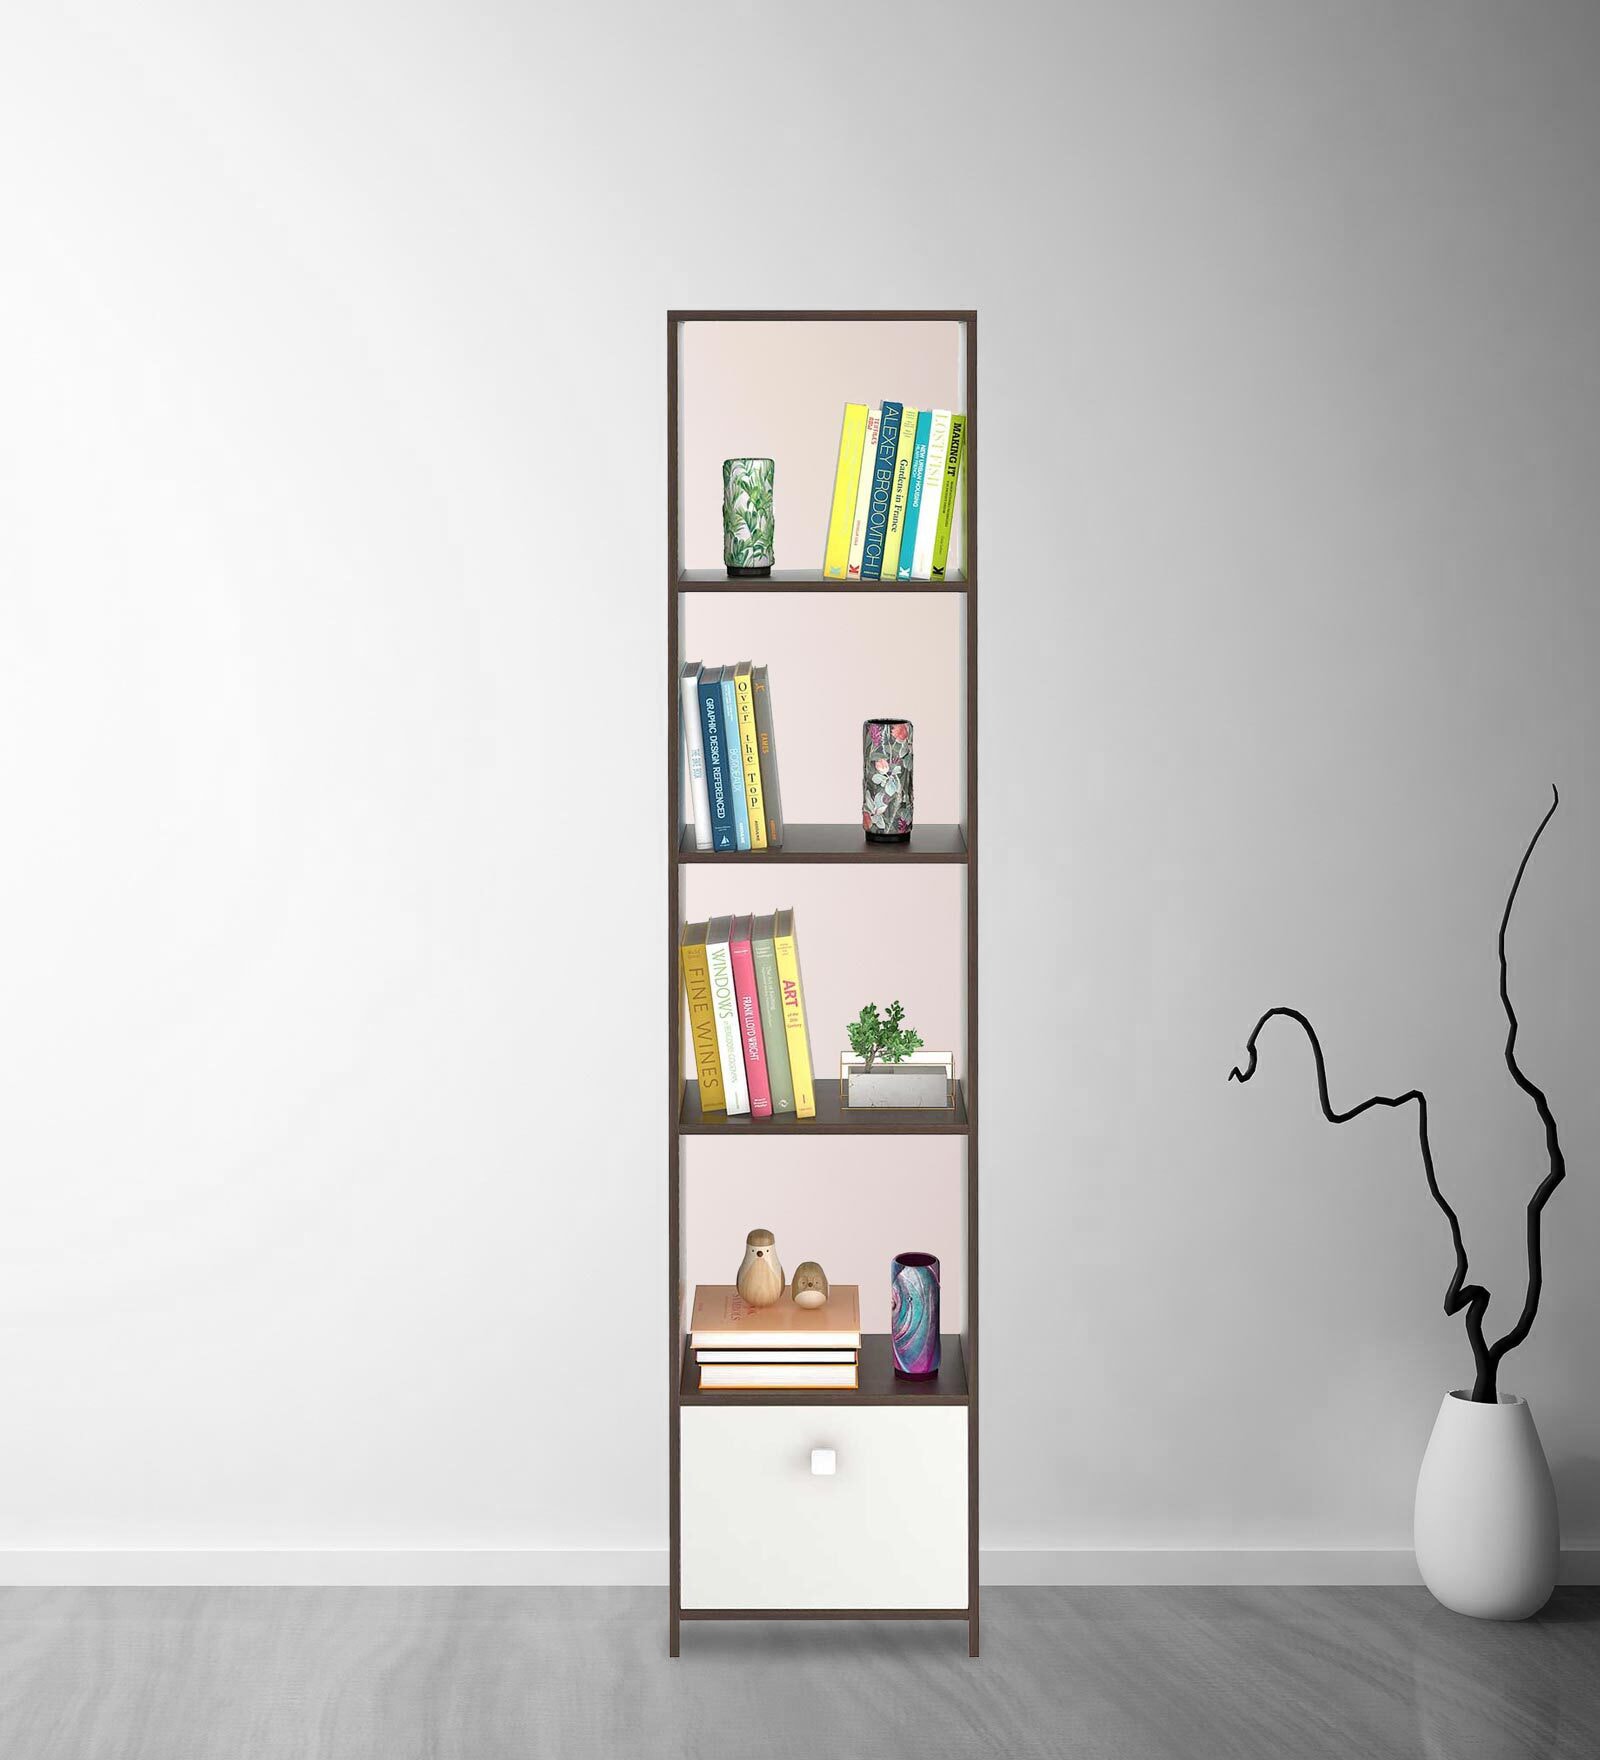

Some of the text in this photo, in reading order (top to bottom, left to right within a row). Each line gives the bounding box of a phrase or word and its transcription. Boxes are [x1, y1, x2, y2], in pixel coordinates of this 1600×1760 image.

[879, 405, 900, 466] ALEXEY
[926, 414, 948, 487] LOST FISH
[949, 422, 962, 464] MAKING
[892, 459, 908, 532] Gardens in France
[912, 444, 927, 508] NEW URBAN HOUSING
[947, 465, 957, 477] IT
[866, 470, 891, 568] BRODOVITCH
[705, 698, 718, 734] GRAPHIC
[738, 681, 758, 807] Over the Top
[709, 735, 721, 765] DESIGN
[712, 766, 726, 819] REFERENCED
[689, 967, 709, 1013] FINE
[711, 948, 734, 1019] WINDOWS
[782, 979, 799, 1008] ART
[696, 1021, 719, 1089] WINES
[742, 996, 760, 1061] FRANK LLOYD WRIGHT
